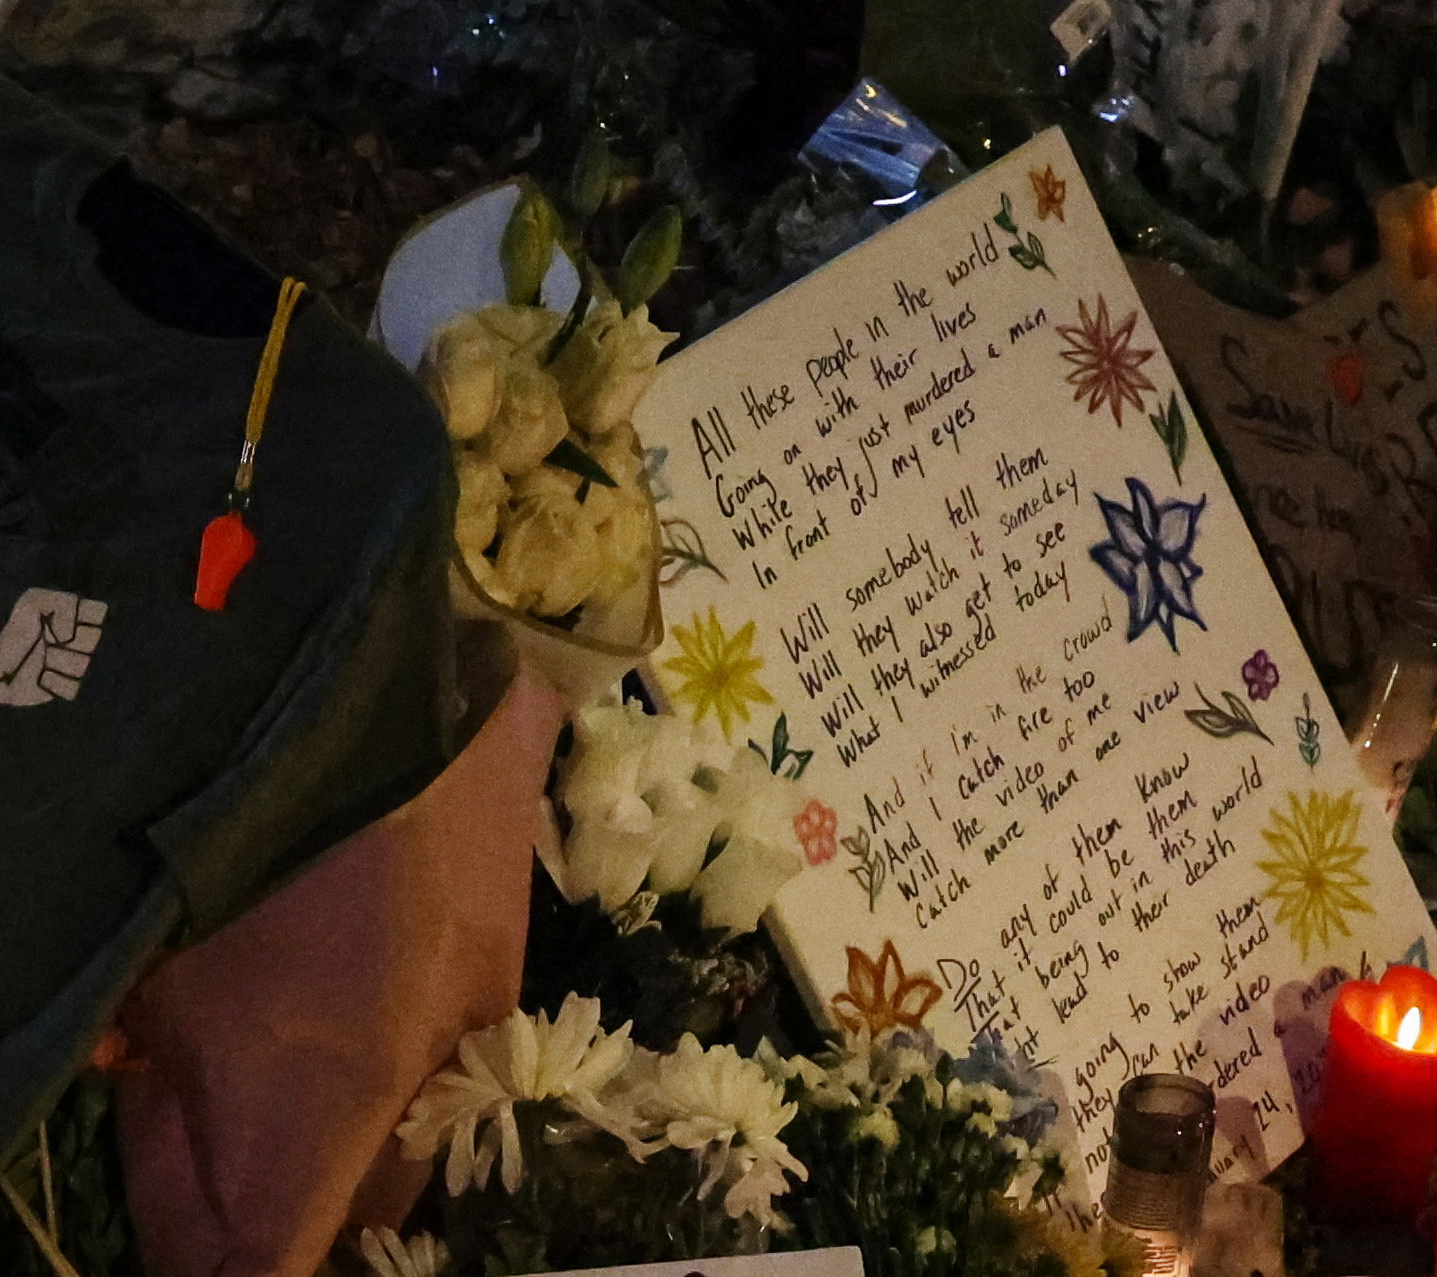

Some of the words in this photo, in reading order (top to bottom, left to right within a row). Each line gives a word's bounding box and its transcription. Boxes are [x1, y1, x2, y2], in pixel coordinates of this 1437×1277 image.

[690, 405, 737, 480] All
[739, 383, 795, 430] these
[804, 326, 875, 398] people
[864, 315, 889, 342] in
[892, 279, 933, 317] the
[944, 221, 999, 287] world
[714, 468, 775, 518] Going
[782, 443, 802, 465] on
[814, 386, 859, 438] with
[869, 347, 917, 391] their
[930, 301, 976, 343] lives
[800, 455, 859, 496] they
[848, 412, 892, 493] just
[903, 352, 976, 425] murdered
[987, 342, 1001, 358] a
[1008, 307, 1046, 344] man
[751, 560, 778, 590] In
[784, 508, 830, 561] front
[842, 472, 877, 516] of
[891, 444, 925, 478] my
[930, 399, 975, 454] eyes
[778, 601, 830, 664] Will
[844, 532, 946, 612] somebody
[943, 484, 980, 529] tell
[994, 446, 1049, 489] them
[835, 714, 881, 768] What
[890, 695, 904, 723] I
[918, 619, 997, 699] witnessed
[1014, 559, 1070, 612] today
[882, 820, 922, 874] And
[927, 795, 942, 821] I
[1016, 705, 1053, 741] fire
[1062, 670, 1095, 703] too
[935, 957, 981, 1001] Do
[999, 902, 1037, 956] any
[1042, 862, 1059, 901] of
[1071, 817, 1122, 866] them
[952, 968, 1014, 1032] That
[1003, 936, 1031, 972] it
[1048, 877, 1093, 934] could
[1104, 848, 1134, 879] be
[1145, 789, 1197, 840] them
[1096, 940, 1120, 970] to
[1183, 828, 1236, 887] death
[1172, 1039, 1207, 1073] the
[1218, 974, 1270, 1026] video
[1207, 1031, 1262, 1089] rdered
